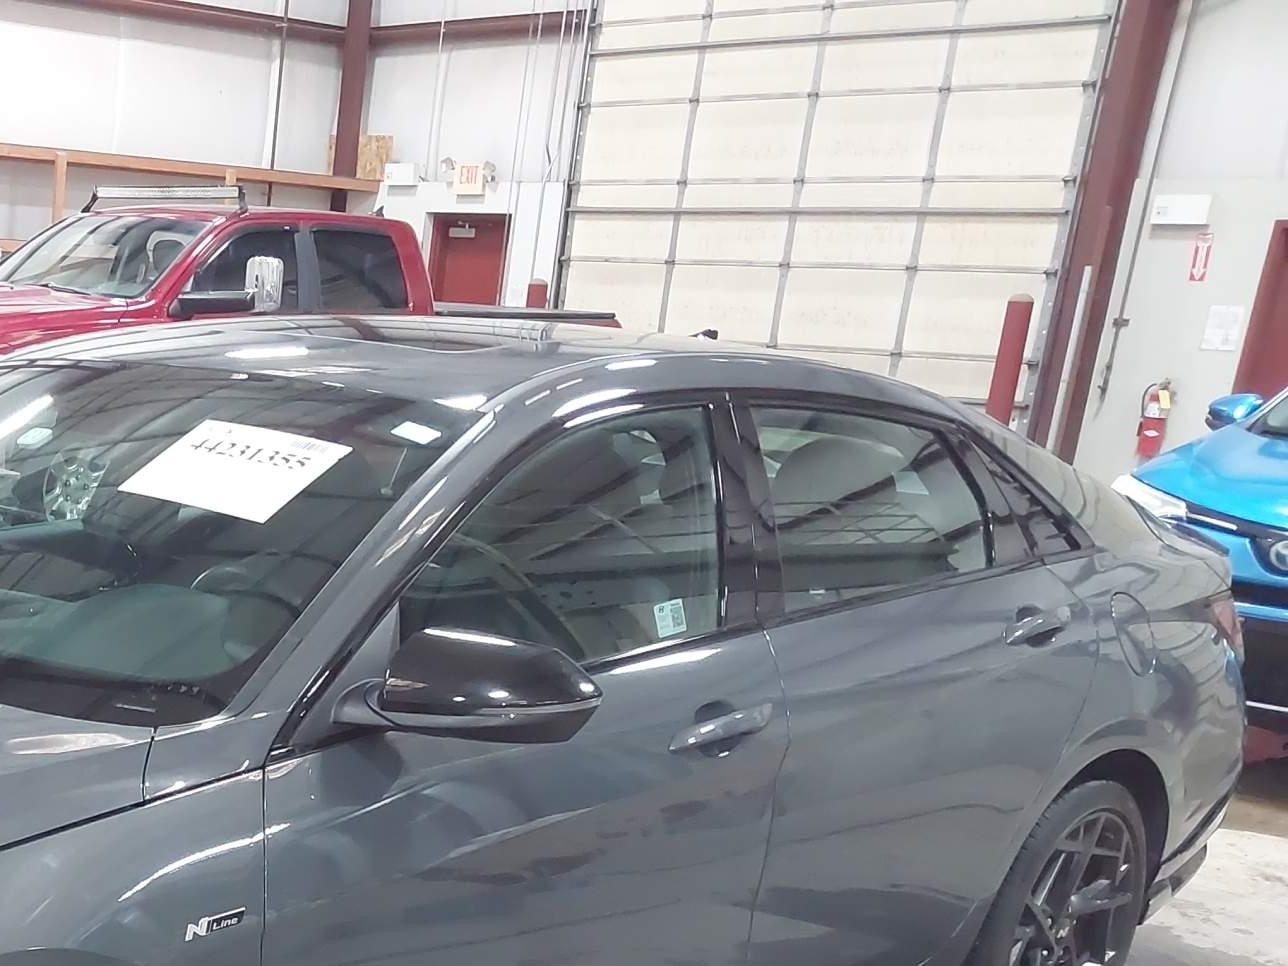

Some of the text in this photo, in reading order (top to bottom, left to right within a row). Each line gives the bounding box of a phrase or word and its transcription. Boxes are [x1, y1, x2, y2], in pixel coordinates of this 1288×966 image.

[459, 165, 480, 185] EXIT
[190, 438, 312, 470] 44231355
[184, 917, 209, 941] N
